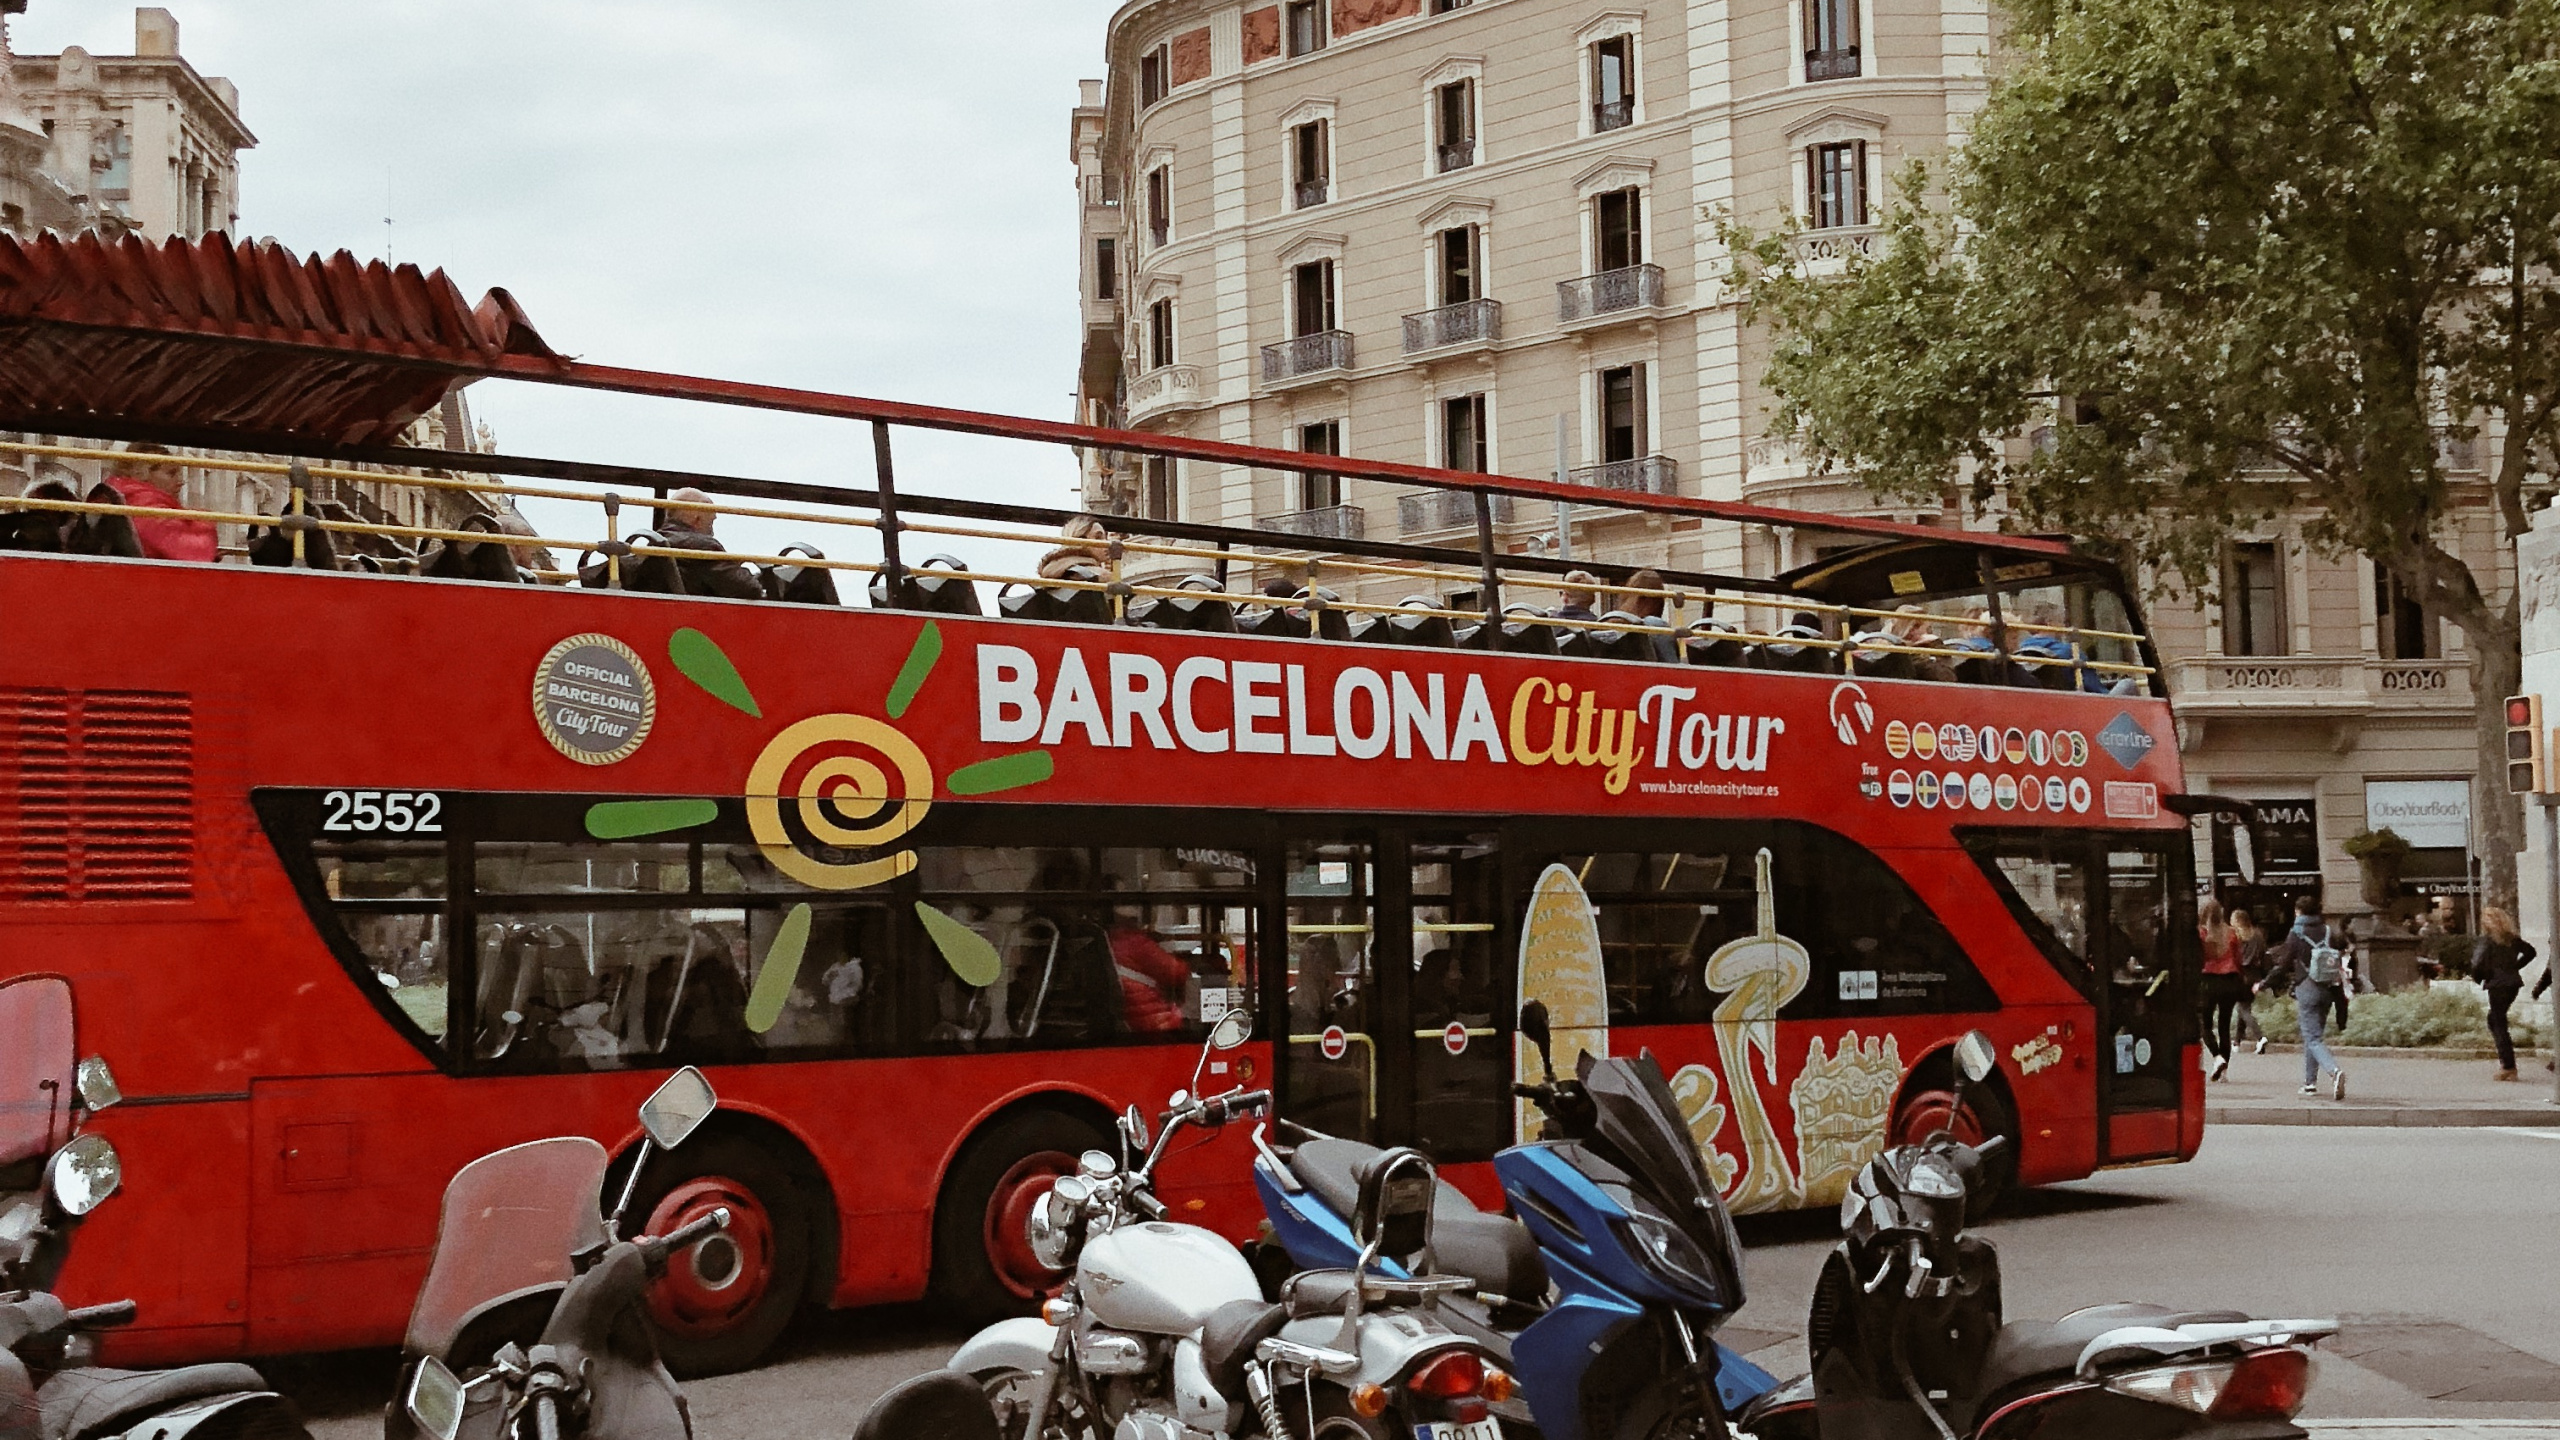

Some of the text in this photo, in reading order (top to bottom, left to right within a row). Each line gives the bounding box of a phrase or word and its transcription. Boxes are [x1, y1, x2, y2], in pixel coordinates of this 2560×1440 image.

[564, 661, 632, 688] OFFICIAL
[548, 683, 640, 714] BARCELONA
[976, 643, 1785, 795] BARCELONA City Tour
[1640, 780, 1780, 799] www.barcelonacitytour.es
[323, 791, 442, 832] 2552
[2216, 808, 2310, 824] OAMA
